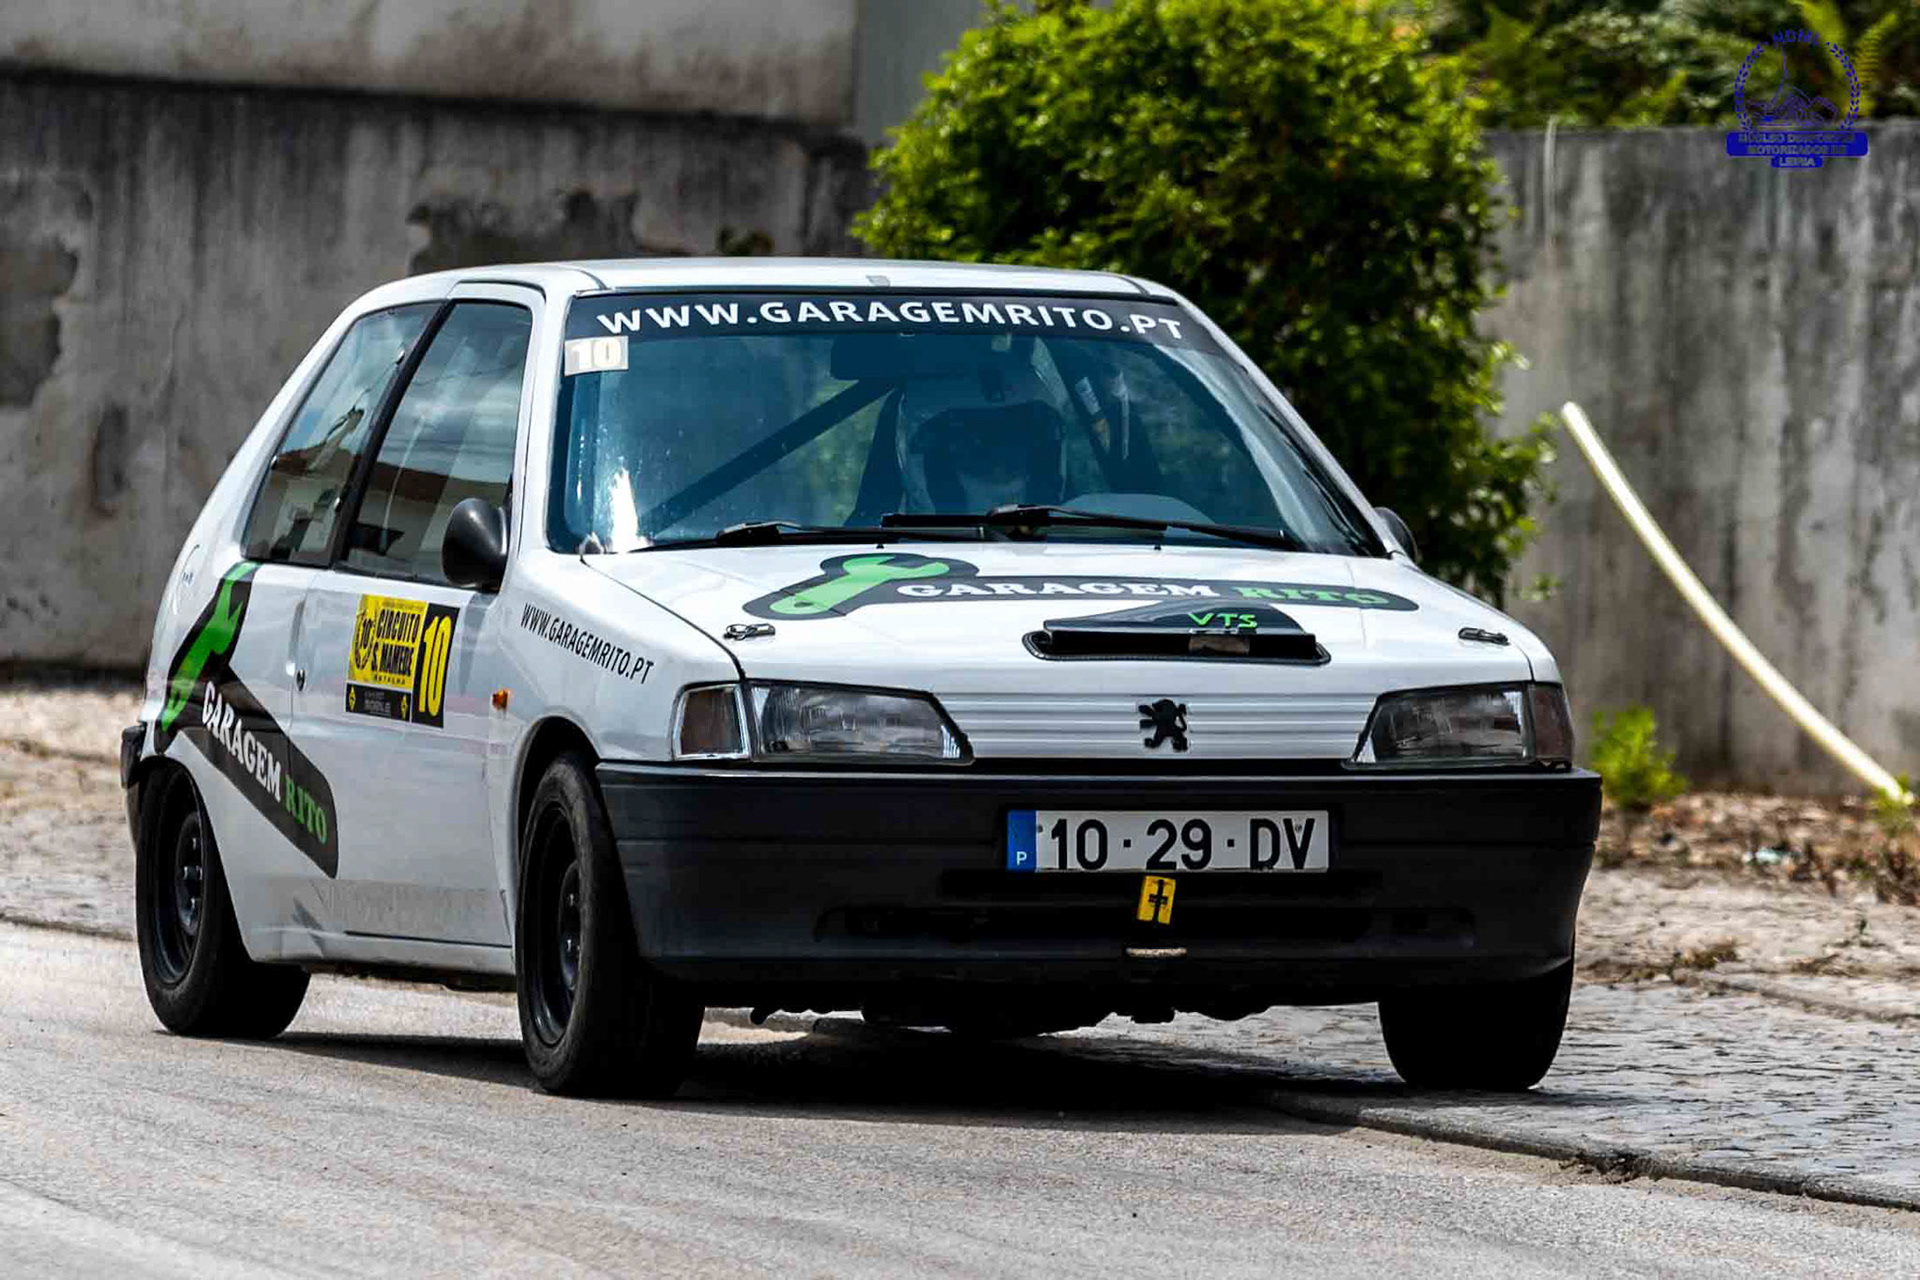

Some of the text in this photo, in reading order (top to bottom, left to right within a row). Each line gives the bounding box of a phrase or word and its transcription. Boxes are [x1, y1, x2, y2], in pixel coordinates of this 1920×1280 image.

[597, 301, 1182, 339] WWW.GARAGEMRITO.PT
[567, 339, 622, 372] 10
[897, 583, 1390, 605] GARAGEM RITO
[377, 608, 421, 644] CIRCUITO
[1188, 612, 1258, 629] VTS
[520, 602, 655, 685] WWW.GARAGEMRITO.PT
[418, 615, 452, 717] 10
[202, 681, 328, 845] GARAGEM RITO
[1016, 851, 1028, 866] P
